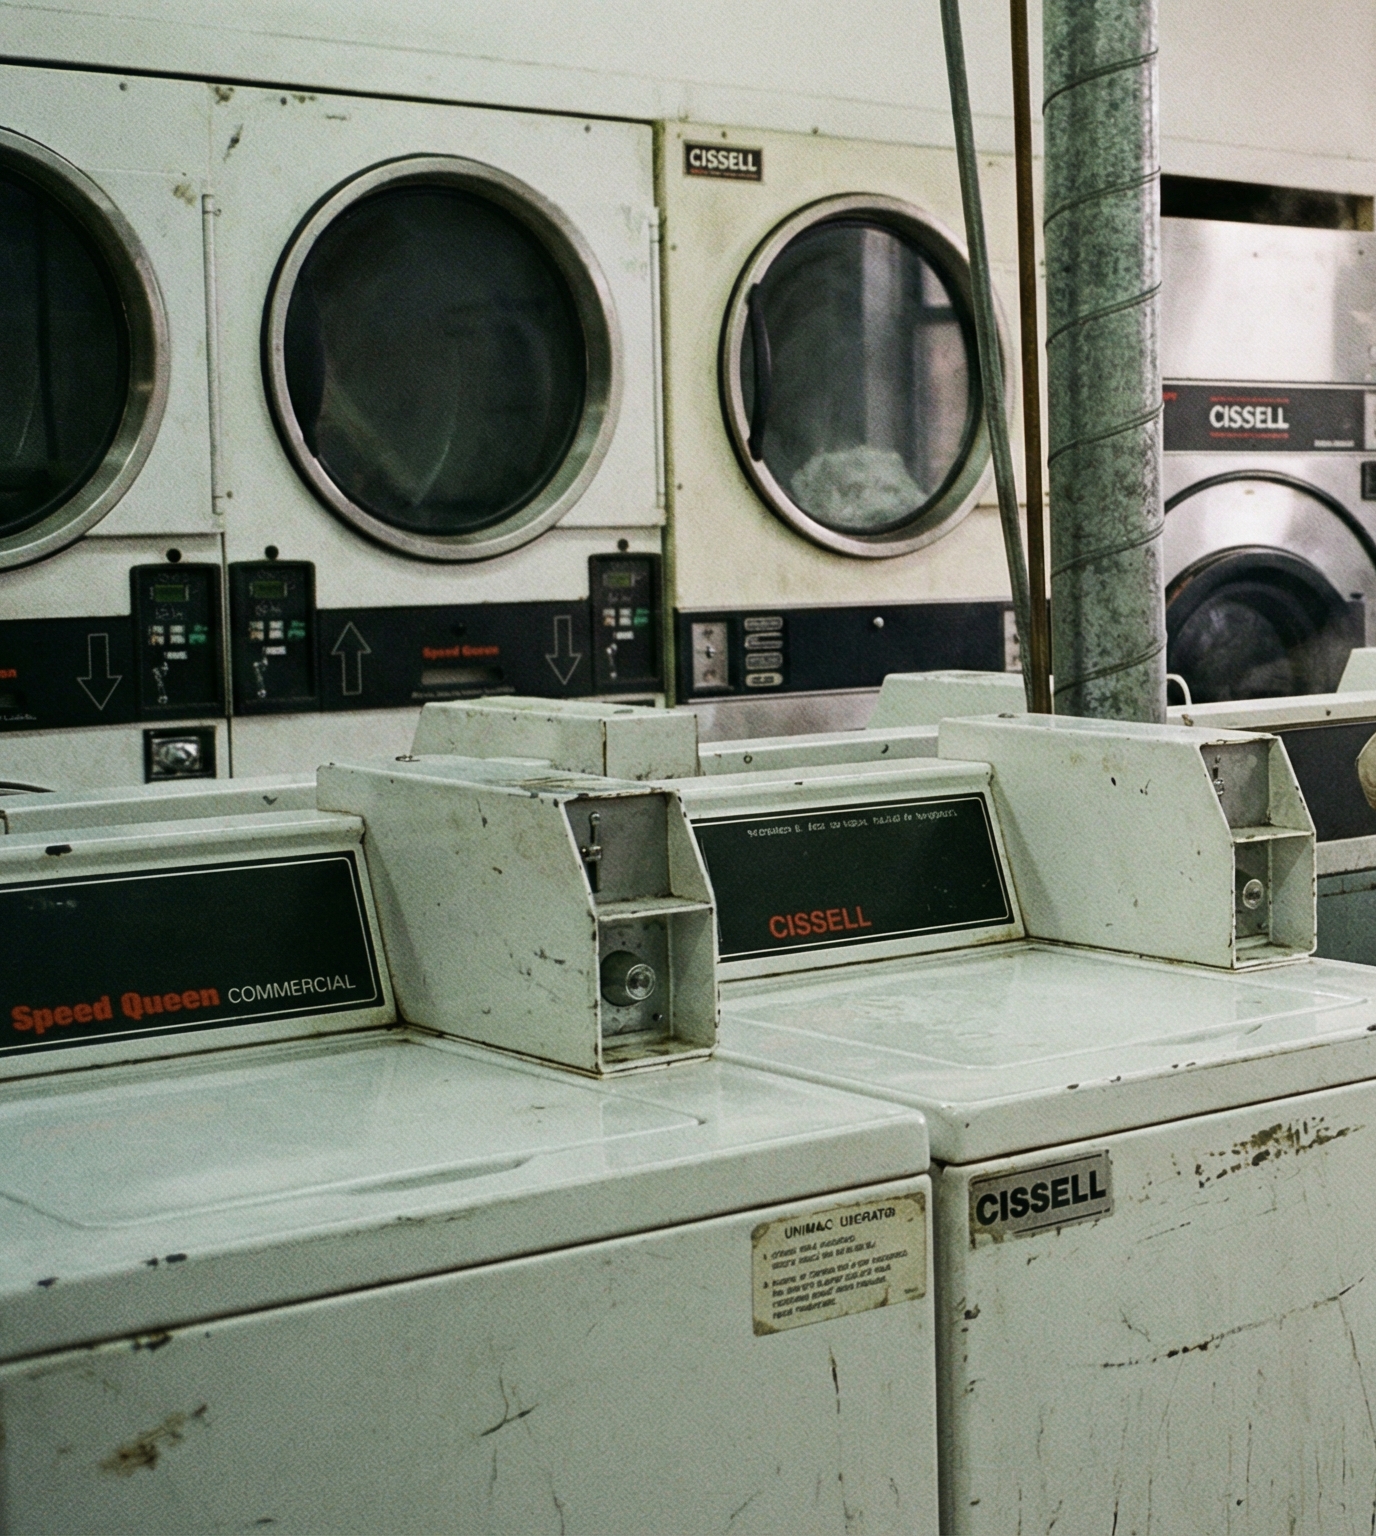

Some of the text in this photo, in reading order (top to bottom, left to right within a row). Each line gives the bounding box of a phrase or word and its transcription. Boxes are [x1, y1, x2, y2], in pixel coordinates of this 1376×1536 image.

[690, 148, 758, 172] CISSELL
[1209, 405, 1290, 429] CISSELL
[769, 906, 872, 939] CISSELL
[11, 974, 356, 1034] Speed Queen COMMERCIAL
[976, 1169, 1107, 1226] CISSELL
